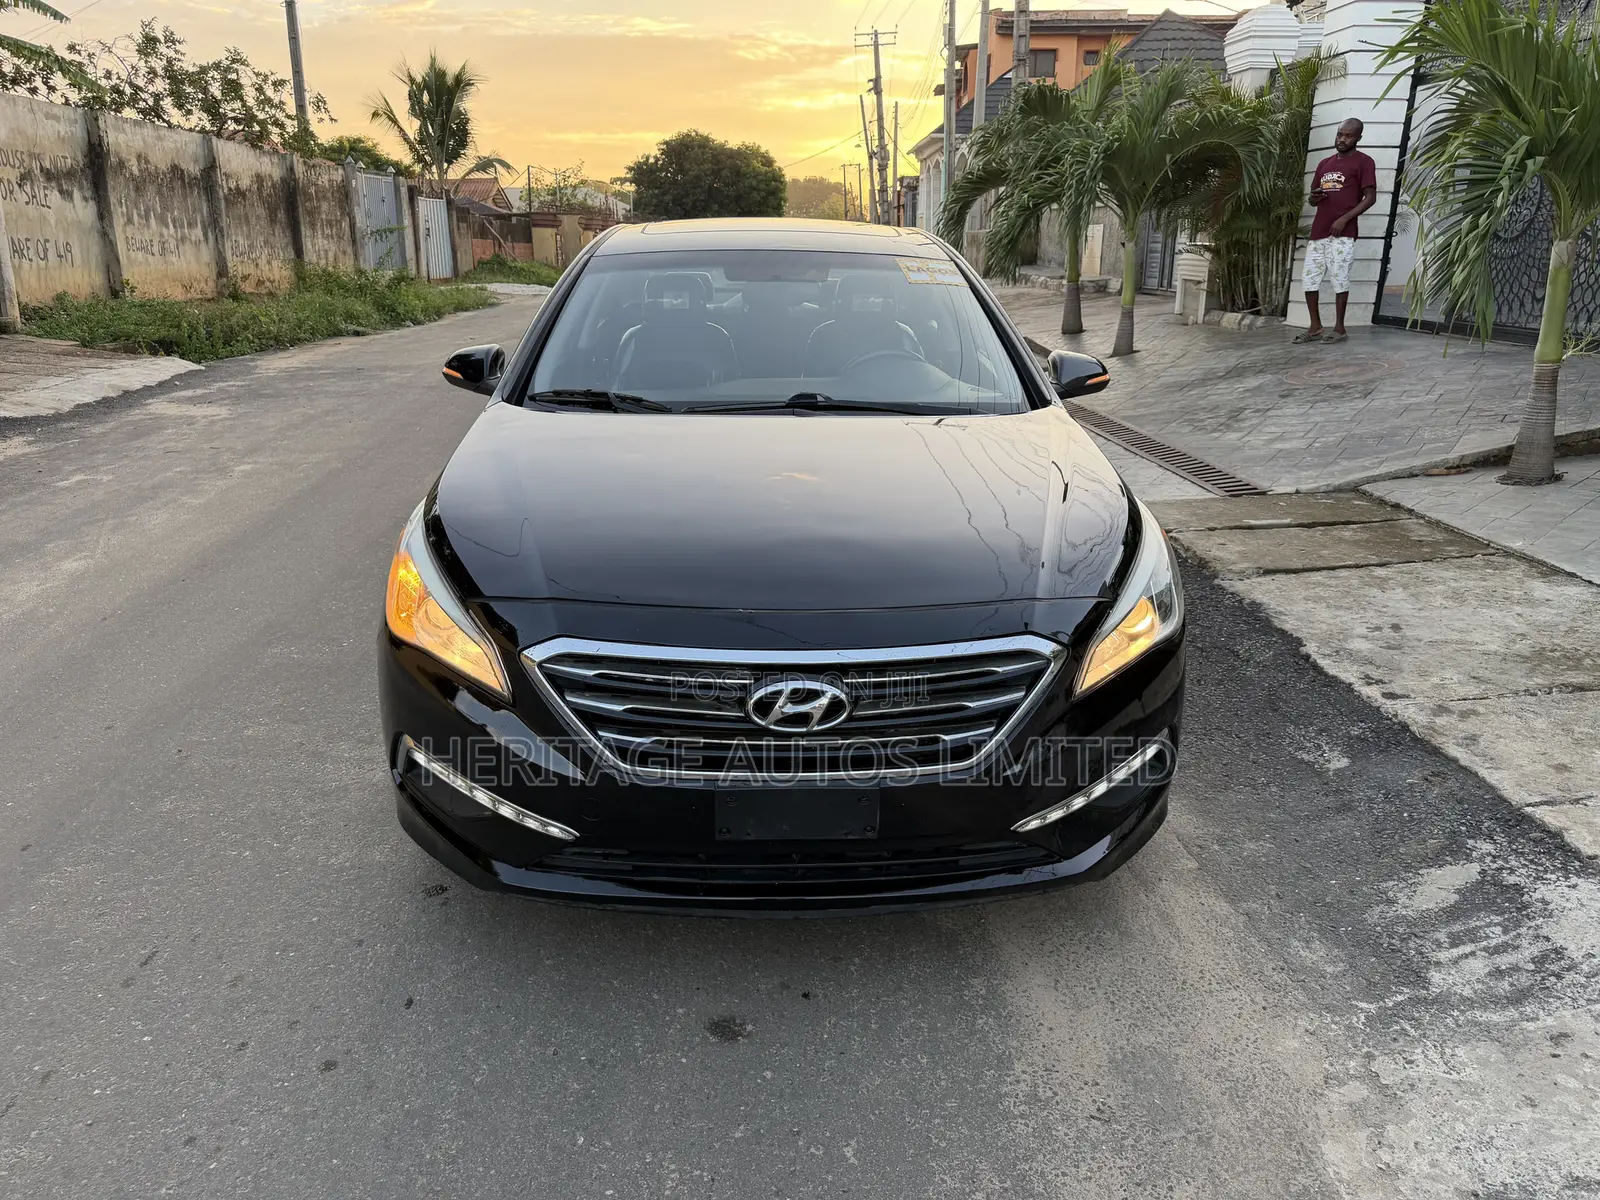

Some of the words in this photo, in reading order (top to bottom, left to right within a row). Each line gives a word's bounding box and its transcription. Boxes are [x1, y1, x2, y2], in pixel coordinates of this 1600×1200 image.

[0, 148, 27, 170] OUSE
[0, 177, 17, 203] OR
[22, 181, 52, 209] SALE
[9, 236, 33, 262] ARE
[36, 238, 50, 262] OF
[54, 239, 74, 268] 419
[126, 235, 155, 257] BEWARE
[157, 240, 167, 257] OF
